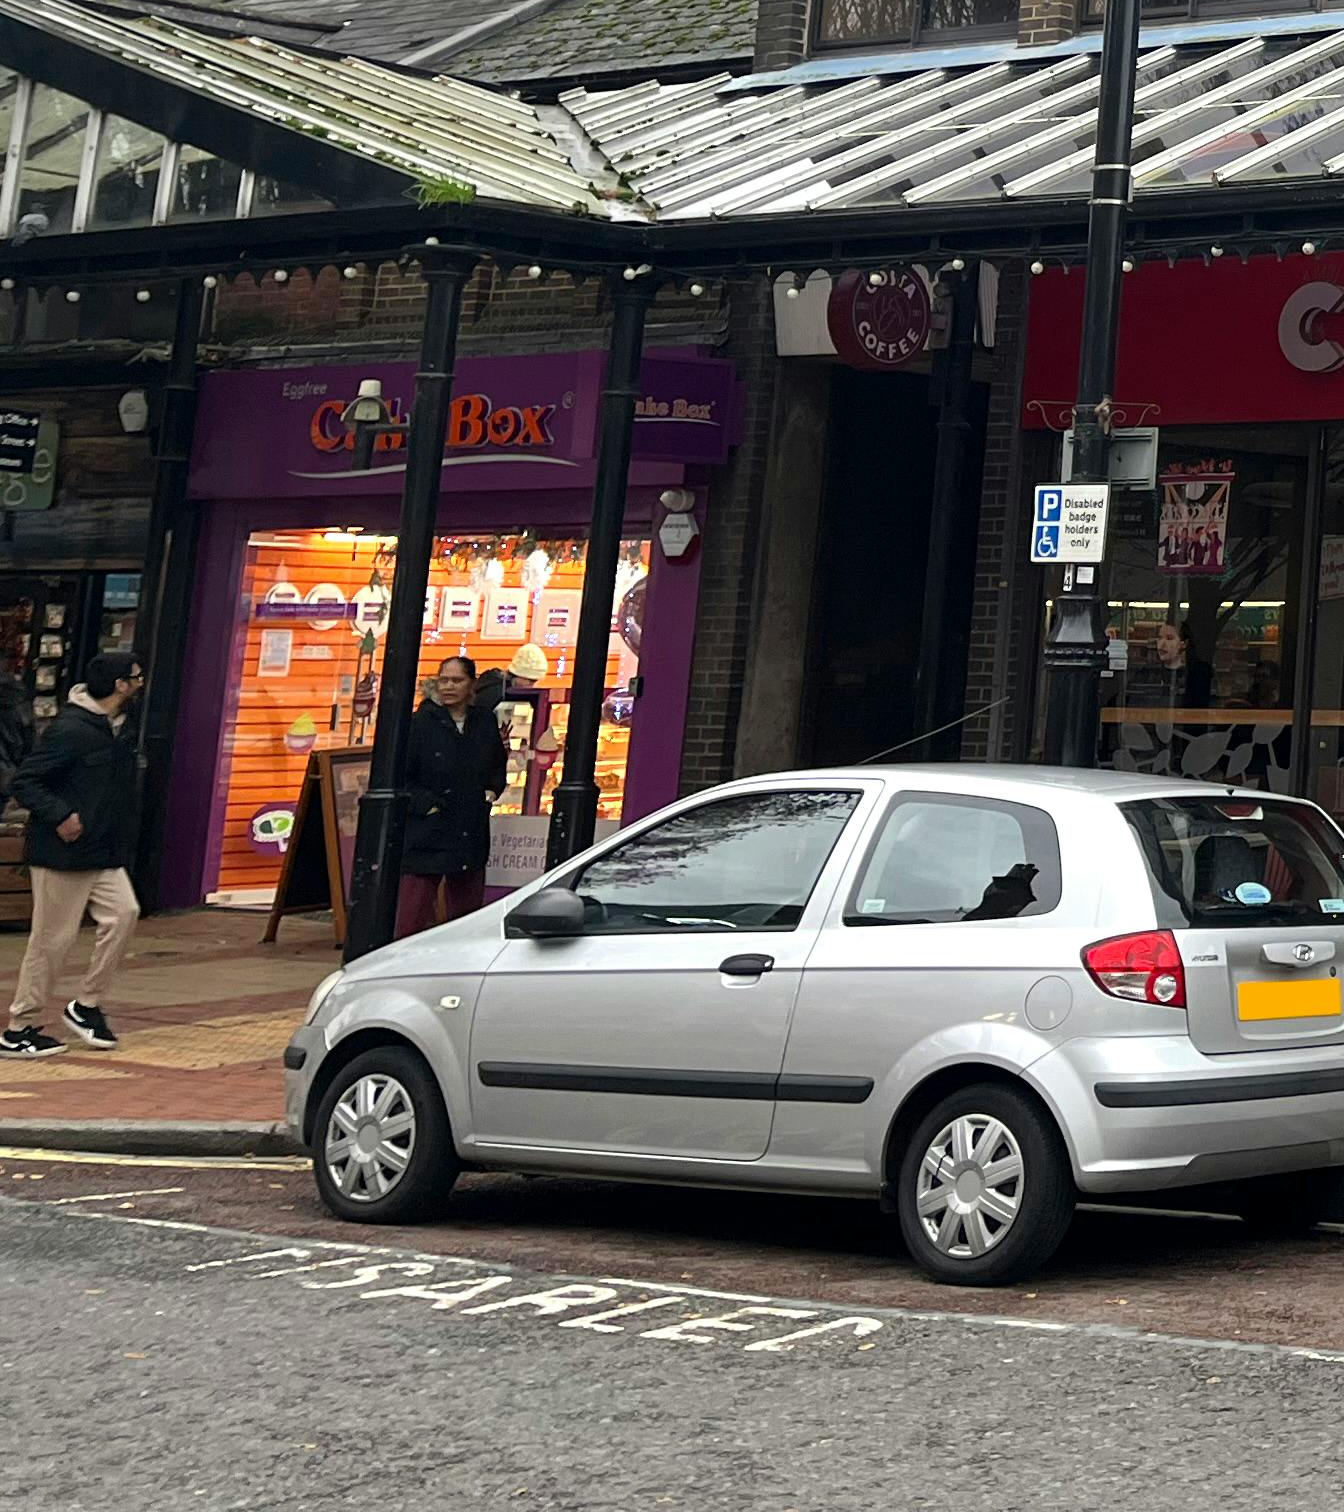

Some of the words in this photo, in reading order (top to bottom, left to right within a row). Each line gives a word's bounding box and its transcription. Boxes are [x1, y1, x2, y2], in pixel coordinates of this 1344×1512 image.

[858, 321, 919, 359] COFFEE
[634, 396, 670, 417] ake
[672, 398, 711, 420] Box
[447, 393, 556, 448] Box
[1064, 498, 1104, 509] Disabled
[1068, 512, 1097, 524] badge
[1064, 524, 1099, 535] holders
[1070, 538, 1091, 549] only
[501, 833, 545, 850] Vegetaria
